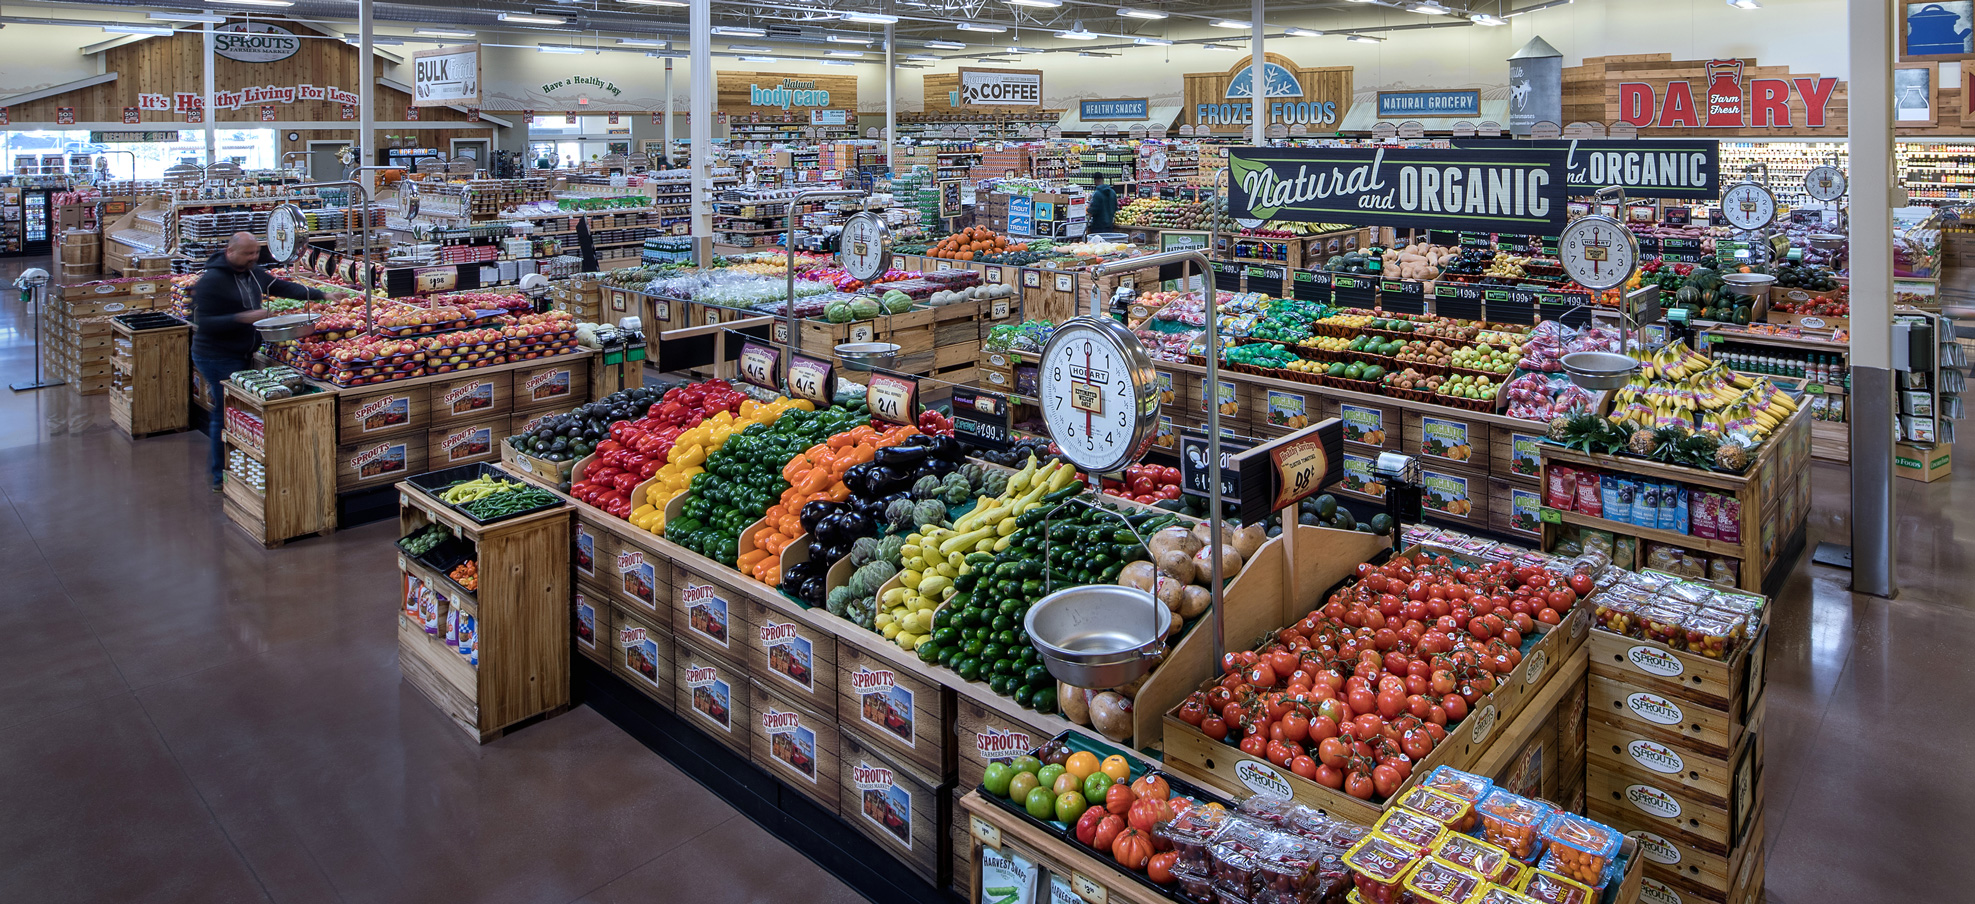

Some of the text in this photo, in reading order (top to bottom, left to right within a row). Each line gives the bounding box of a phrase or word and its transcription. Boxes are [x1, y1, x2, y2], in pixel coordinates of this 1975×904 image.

[215, 34, 295, 51] SPROUTS
[417, 56, 476, 83] BULK Foods
[542, 79, 563, 94] Have
[573, 75, 606, 90] Healthy
[606, 82, 622, 97] Day
[783, 78, 815, 90] Natural
[980, 83, 1038, 100] COFFEE
[244, 86, 293, 103] Living
[301, 87, 323, 99] For
[330, 88, 357, 104] Less
[751, 83, 830, 110] body care
[1383, 95, 1474, 110] NATURAL GROCERY
[1710, 94, 1740, 104] Farm
[1085, 103, 1142, 115] HEALTHY SNACKS
[1197, 101, 1337, 125] FROZE FOODS
[1710, 105, 1740, 115] Fresh
[153, 132, 178, 142] RELAX
[1567, 168, 1586, 184] nd
[1590, 151, 1706, 188] ORGANIC
[1243, 147, 1550, 217] Natural and ORGANIC
[1010, 204, 1030, 213] TROUT
[1009, 223, 1029, 233] TROUT
[1579, 230, 1585, 238] 9
[1570, 241, 1576, 249] 8
[1617, 244, 1623, 252] 2
[1571, 255, 1577, 263] 7
[1580, 267, 1586, 275] 6
[1065, 346, 1073, 362] 9
[1105, 353, 1110, 369] 1
[526, 369, 557, 389] SPROUTS
[1054, 367, 1062, 382] 8
[444, 381, 479, 403] SPROUTS
[1117, 380, 1126, 397] 2
[355, 395, 393, 420] SPROUTS
[1055, 395, 1063, 411] 7
[1270, 396, 1303, 411] ORGANIC
[1118, 411, 1127, 427] 3
[1343, 410, 1380, 426] ORGANIC
[442, 427, 477, 449] SPROUTS
[1067, 422, 1075, 437] 6
[1425, 423, 1465, 440] ORGANIC
[1433, 433, 1458, 441] PRODUCE
[1086, 435, 1094, 451] 5
[1104, 431, 1114, 447] 4
[351, 443, 390, 467] SPROUTS
[1425, 476, 1465, 495] ORGANIC
[1433, 486, 1458, 496] PRODUCE
[618, 552, 643, 567] SPROUTS
[683, 585, 714, 602] SPROUTS
[620, 628, 646, 642] SPROUTS
[761, 625, 796, 641] SPROUTS
[1632, 651, 1680, 671] SPROUTS
[685, 667, 717, 683] SPROUTS
[852, 671, 894, 688] SPROUTS
[1631, 698, 1679, 719] SPROUTS
[763, 713, 799, 727] SPROUTS
[1473, 710, 1494, 742] SPROUTS
[977, 733, 1029, 751] SPROUTS
[1631, 743, 1680, 769] SPROUTS
[853, 767, 893, 786] SPROUTS
[1239, 766, 1291, 796] SPROUTS
[1629, 789, 1677, 813] SPROUTS
[1458, 846, 1478, 864] ONE
[1637, 838, 1677, 859] PROUTS
[1365, 851, 1395, 869] ONE
[983, 855, 1012, 871] HARVEST
[1011, 861, 1027, 884] SNAPS
[1432, 873, 1452, 892] ONE
[1442, 877, 1459, 896] SWEET
[1544, 881, 1561, 900] ONE
[1556, 887, 1569, 904] SWEET
[1640, 884, 1678, 904] PROUTS
